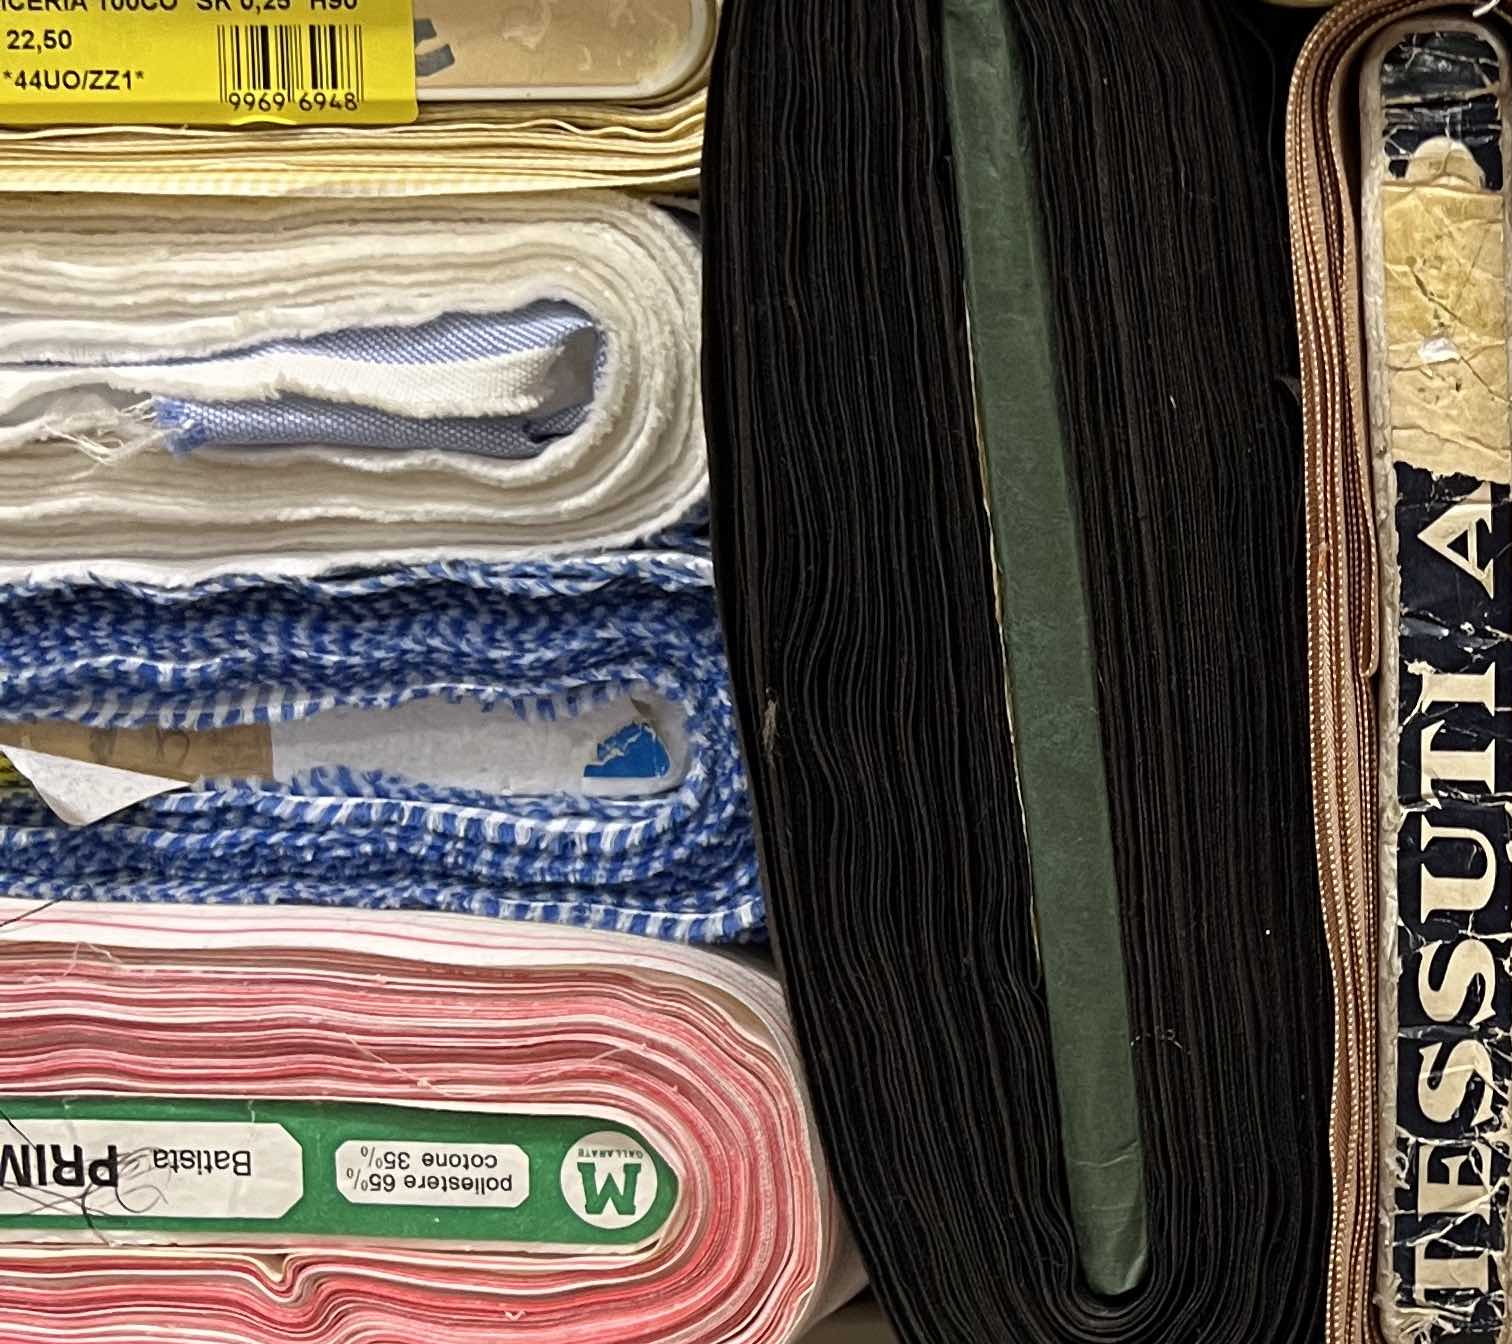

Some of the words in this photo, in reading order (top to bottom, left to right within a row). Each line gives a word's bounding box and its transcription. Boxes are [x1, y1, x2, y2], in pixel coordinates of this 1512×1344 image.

[6, 28, 73, 54] 22,50
[228, 91, 287, 113] 9969
[299, 91, 359, 112] 6948
[1413, 661, 1498, 1307] TESSUTI
[153, 1148, 252, 1177] Batista
[360, 1145, 411, 1170] 35%
[421, 1151, 499, 1170] cotone
[577, 1147, 644, 1159] GALLARATE
[346, 1167, 397, 1193] 65%
[403, 1172, 514, 1196] poliestere
[576, 1161, 643, 1216] M
